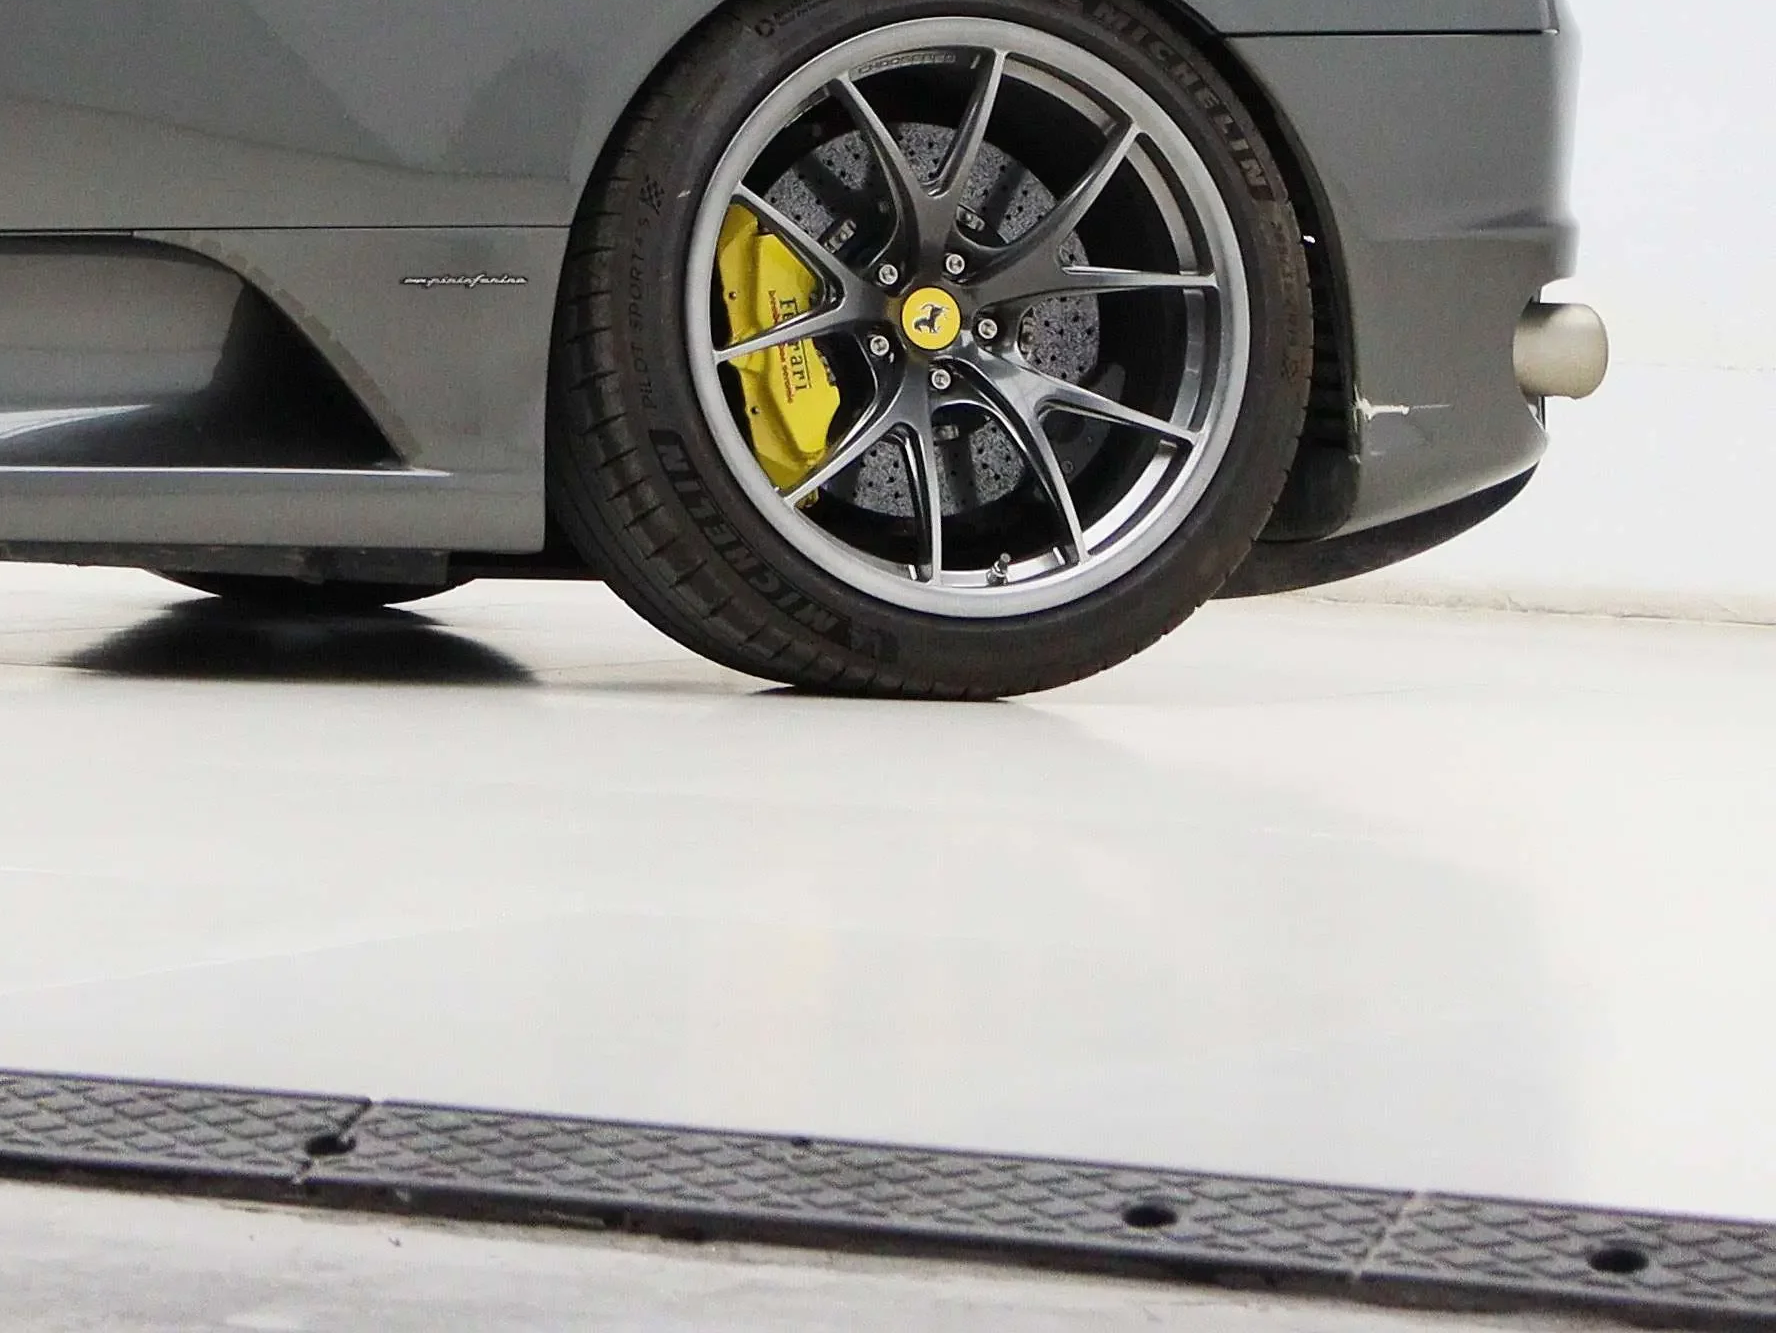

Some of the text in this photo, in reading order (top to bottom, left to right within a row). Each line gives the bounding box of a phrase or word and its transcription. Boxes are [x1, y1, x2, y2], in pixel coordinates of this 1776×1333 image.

[1092, 1, 1268, 187] MICHELIN
[627, 248, 645, 333] SPORT
[630, 341, 657, 409] PILOT
[656, 443, 839, 633] MICHELIN
